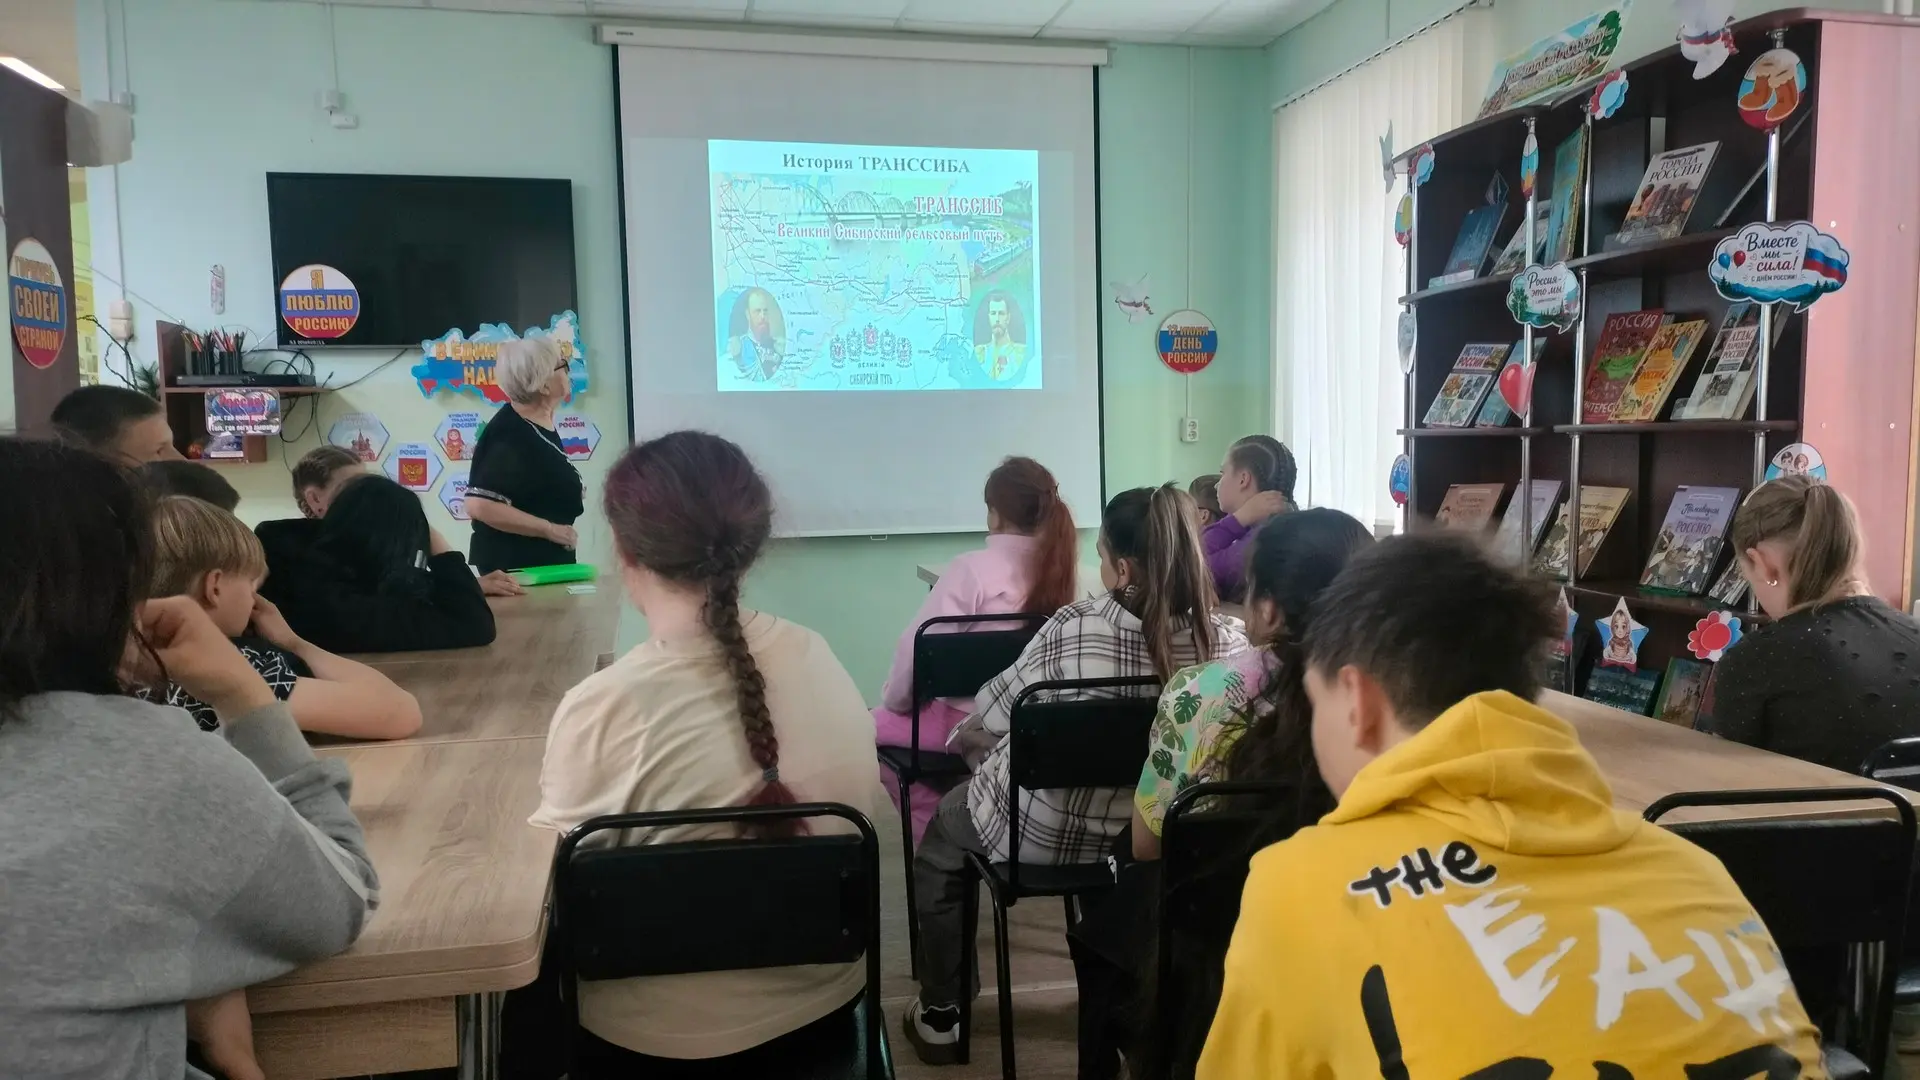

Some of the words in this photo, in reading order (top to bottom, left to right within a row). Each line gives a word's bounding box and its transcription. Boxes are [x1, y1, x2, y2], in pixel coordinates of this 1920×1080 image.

[783, 153, 853, 172] История
[858, 156, 971, 173] ТРАНССИБА
[1649, 163, 1702, 182] РОССИИ
[914, 196, 1003, 214] ТРАНССИБ
[778, 223, 830, 238] Великий
[834, 223, 901, 240] Сибирский
[1745, 232, 1798, 252] Вместе
[1756, 256, 1798, 272] сила!
[1761, 251, 1780, 259] мы
[311, 269, 324, 289] Я
[14, 284, 60, 323] СВОЕЙ
[286, 294, 353, 311] ЛЮБЛЮ
[294, 317, 349, 331] РОССИЮ
[1167, 324, 1178, 335] 12
[1609, 314, 1659, 332] РОССИЯ
[19, 325, 59, 350] СТРАНОЙ
[1173, 337, 1202, 351] ДЕНЬ
[435, 342, 447, 360] В
[1167, 352, 1208, 364] РОССИИ
